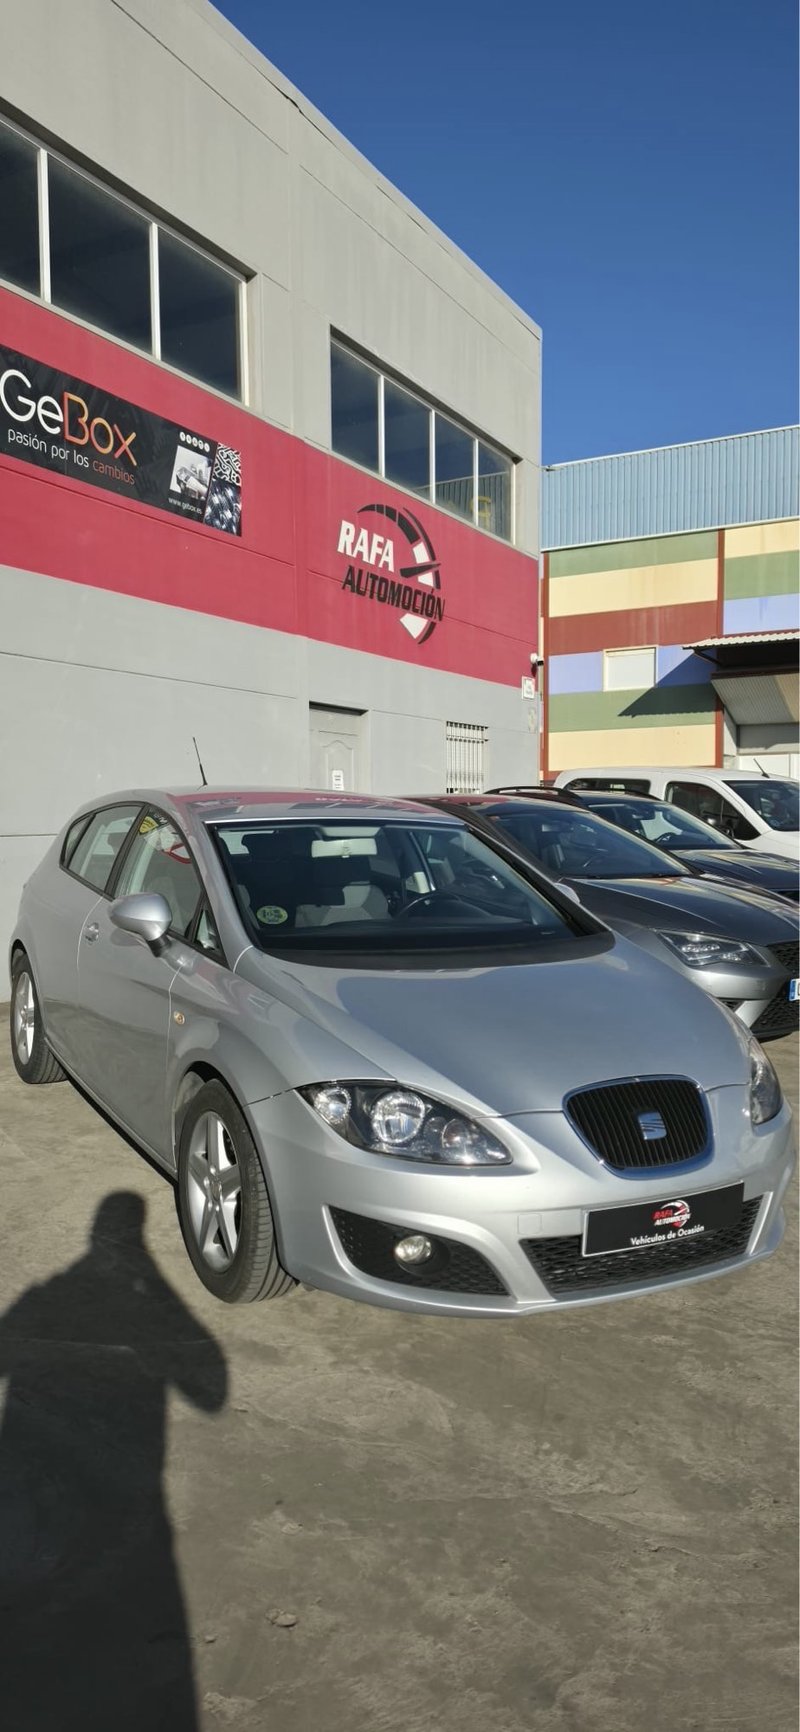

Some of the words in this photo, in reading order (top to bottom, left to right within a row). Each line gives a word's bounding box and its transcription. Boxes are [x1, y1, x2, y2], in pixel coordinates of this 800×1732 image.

[0, 369, 137, 466] GeBox
[8, 428, 47, 453] pasión
[51, 444, 70, 460] por
[73, 449, 89, 468] los
[93, 460, 136, 485] cambios
[337, 519, 395, 573] RAFA
[630, 1232, 666, 1246] Vehículos
[667, 1230, 677, 1240] de
[677, 1224, 705, 1237] Ocasión
[652, 1209, 674, 1220] RAFA
